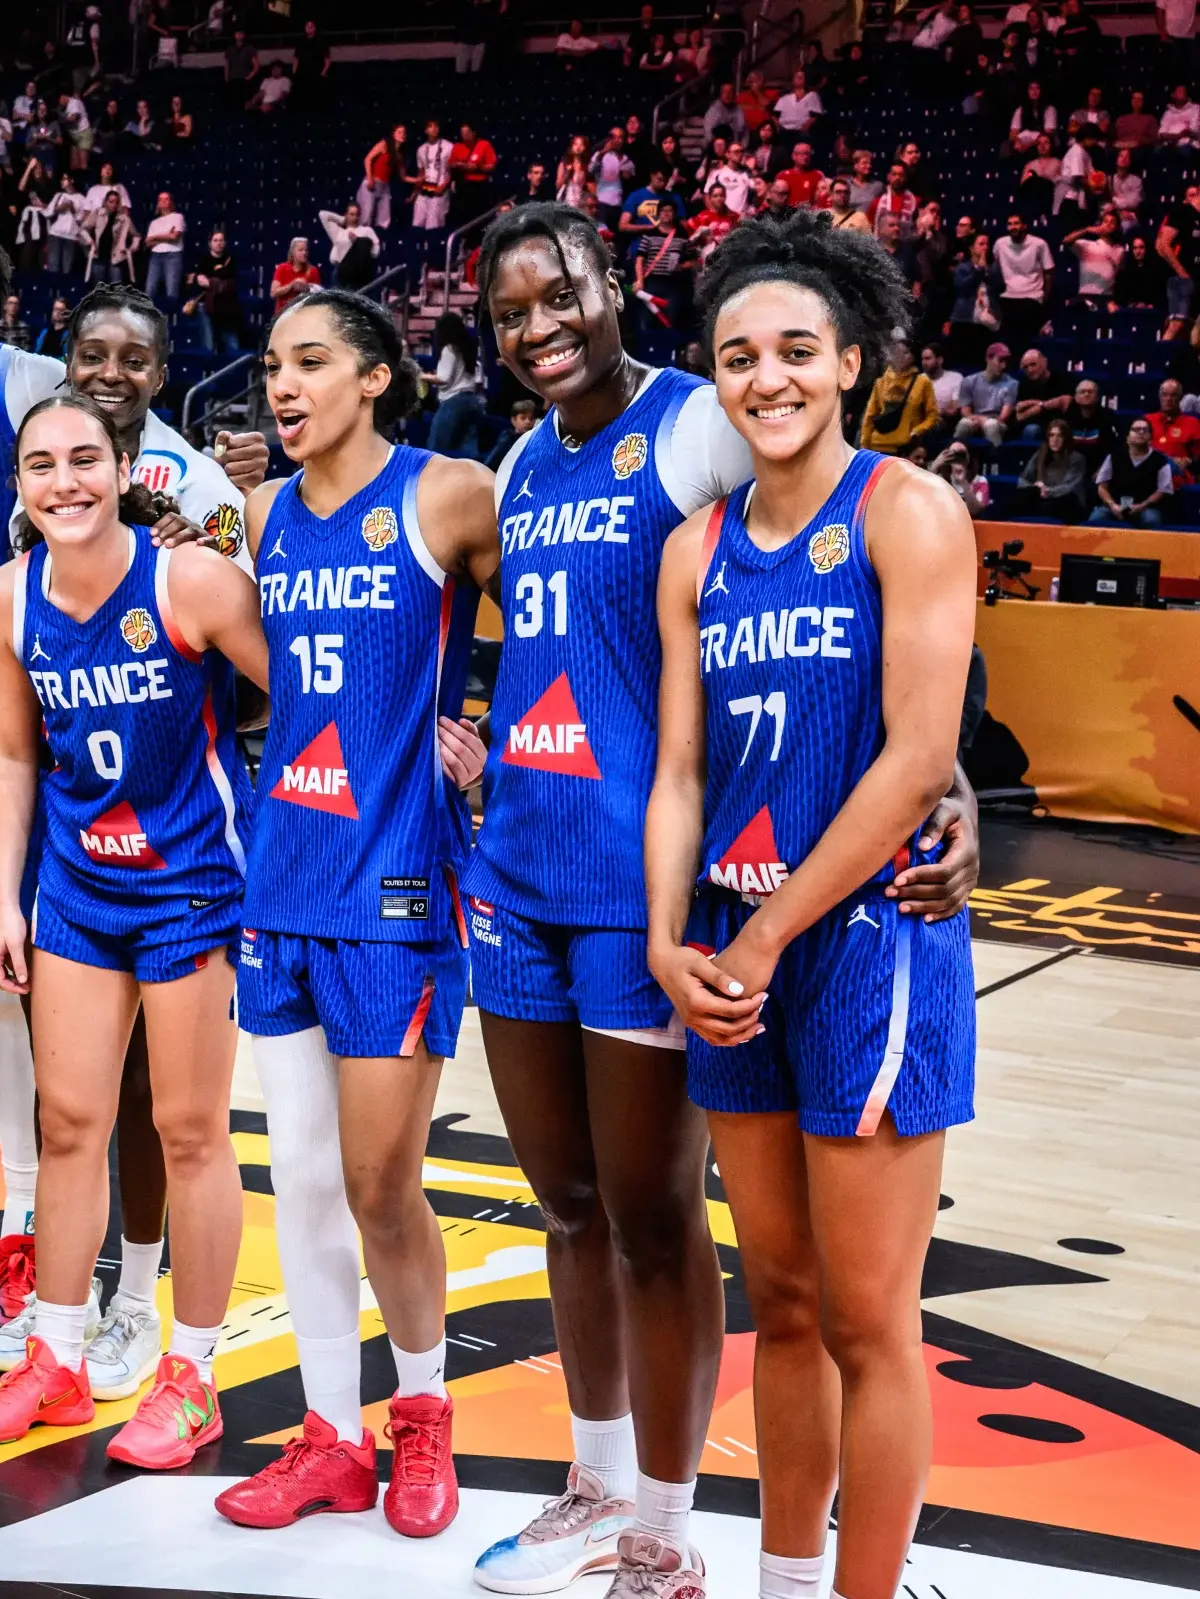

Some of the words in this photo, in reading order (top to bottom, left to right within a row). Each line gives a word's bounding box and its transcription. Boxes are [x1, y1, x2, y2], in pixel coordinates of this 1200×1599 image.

[501, 495, 635, 562] FRANCE
[259, 565, 397, 618] FRANCE
[514, 570, 568, 639] 31
[289, 634, 344, 694] 15
[699, 606, 855, 681] FRANCE
[29, 657, 174, 710] FRANCE
[87, 729, 125, 781] 0
[509, 724, 586, 754] MAIF
[727, 690, 787, 767] 71
[282, 765, 349, 796] MAIF
[79, 828, 148, 858] MAIF
[710, 860, 790, 893] MAIF
[412, 902, 425, 913] 42
